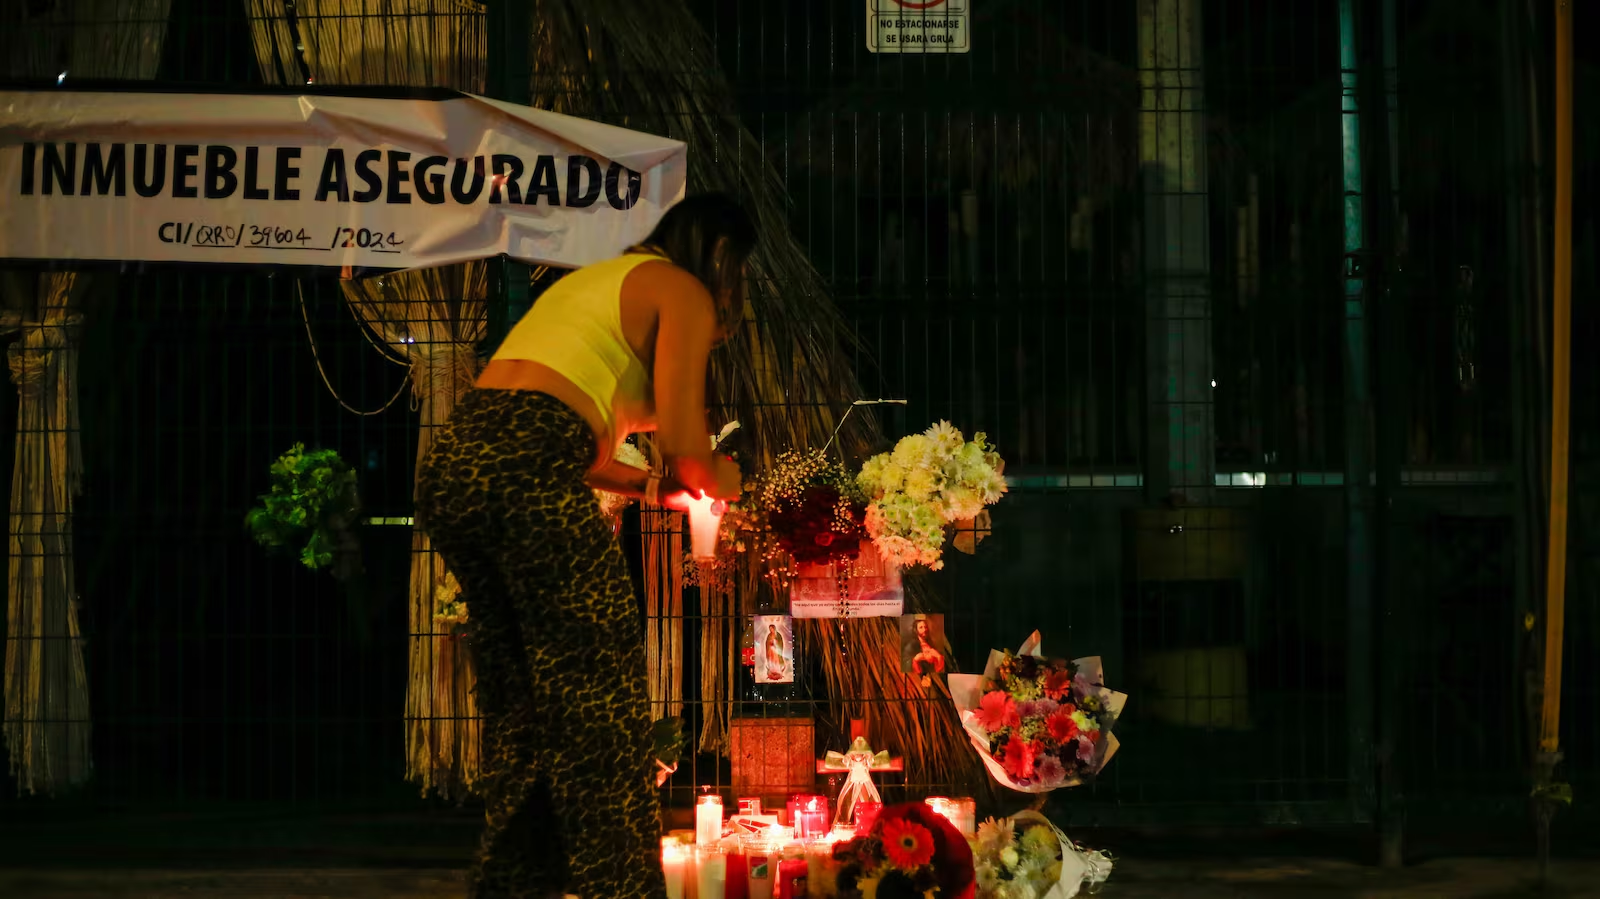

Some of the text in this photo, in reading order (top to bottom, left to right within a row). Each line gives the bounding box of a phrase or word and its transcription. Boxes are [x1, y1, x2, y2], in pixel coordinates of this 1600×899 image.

[880, 19, 892, 28] NO
[886, 34, 954, 43] SE USARA GRUA
[20, 142, 642, 211] INMUEBLE ASEGURADO
